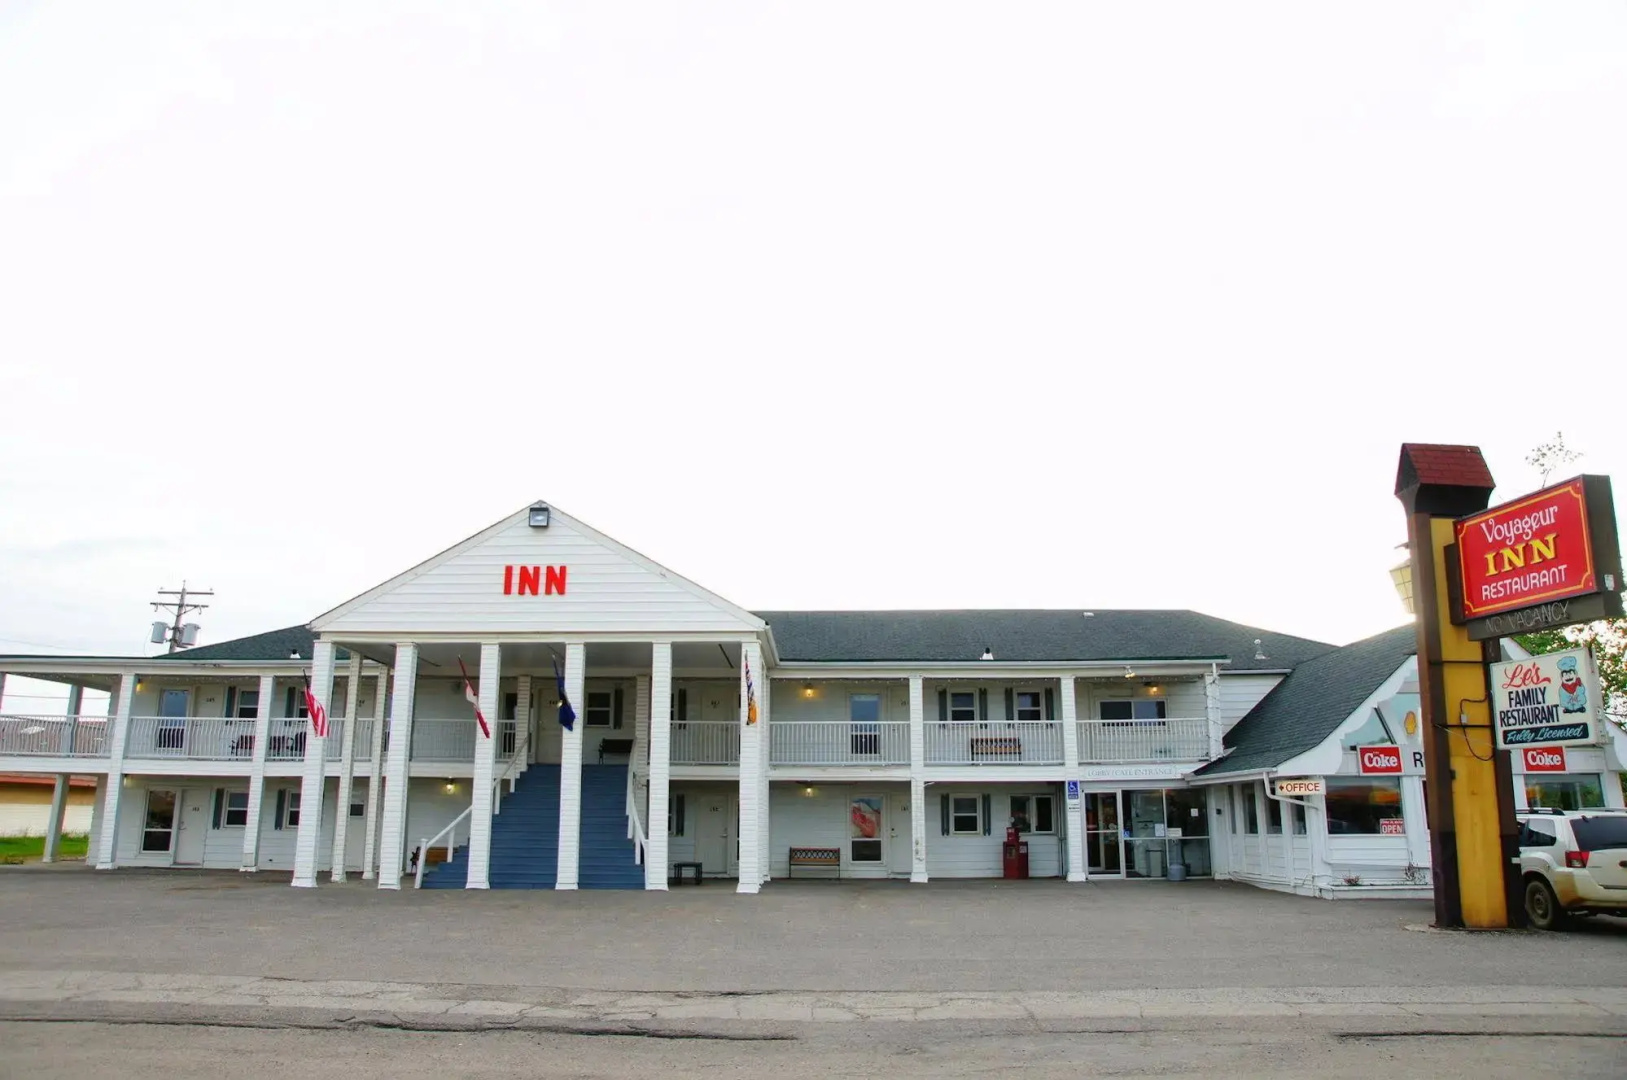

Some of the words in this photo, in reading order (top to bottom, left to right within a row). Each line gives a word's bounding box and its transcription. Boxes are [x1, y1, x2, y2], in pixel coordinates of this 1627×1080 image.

[1480, 506, 1558, 545] Voyageur
[1484, 533, 1558, 577] INN
[503, 565, 567, 595] INN
[1481, 564, 1567, 600] RESTAURANT
[1485, 616, 1502, 632] NO
[1508, 601, 1569, 629] VACANCY
[1502, 662, 1551, 689] Le's
[1508, 686, 1546, 708] FAMILY
[1499, 704, 1560, 727] RESTAURANT
[1506, 729, 1535, 743] Fully
[1535, 724, 1583, 740] Licensed
[1363, 752, 1398, 768] Coke
[1527, 750, 1562, 766] Coke
[1285, 782, 1320, 792] OFFICE
[1382, 824, 1403, 835] OPEN
